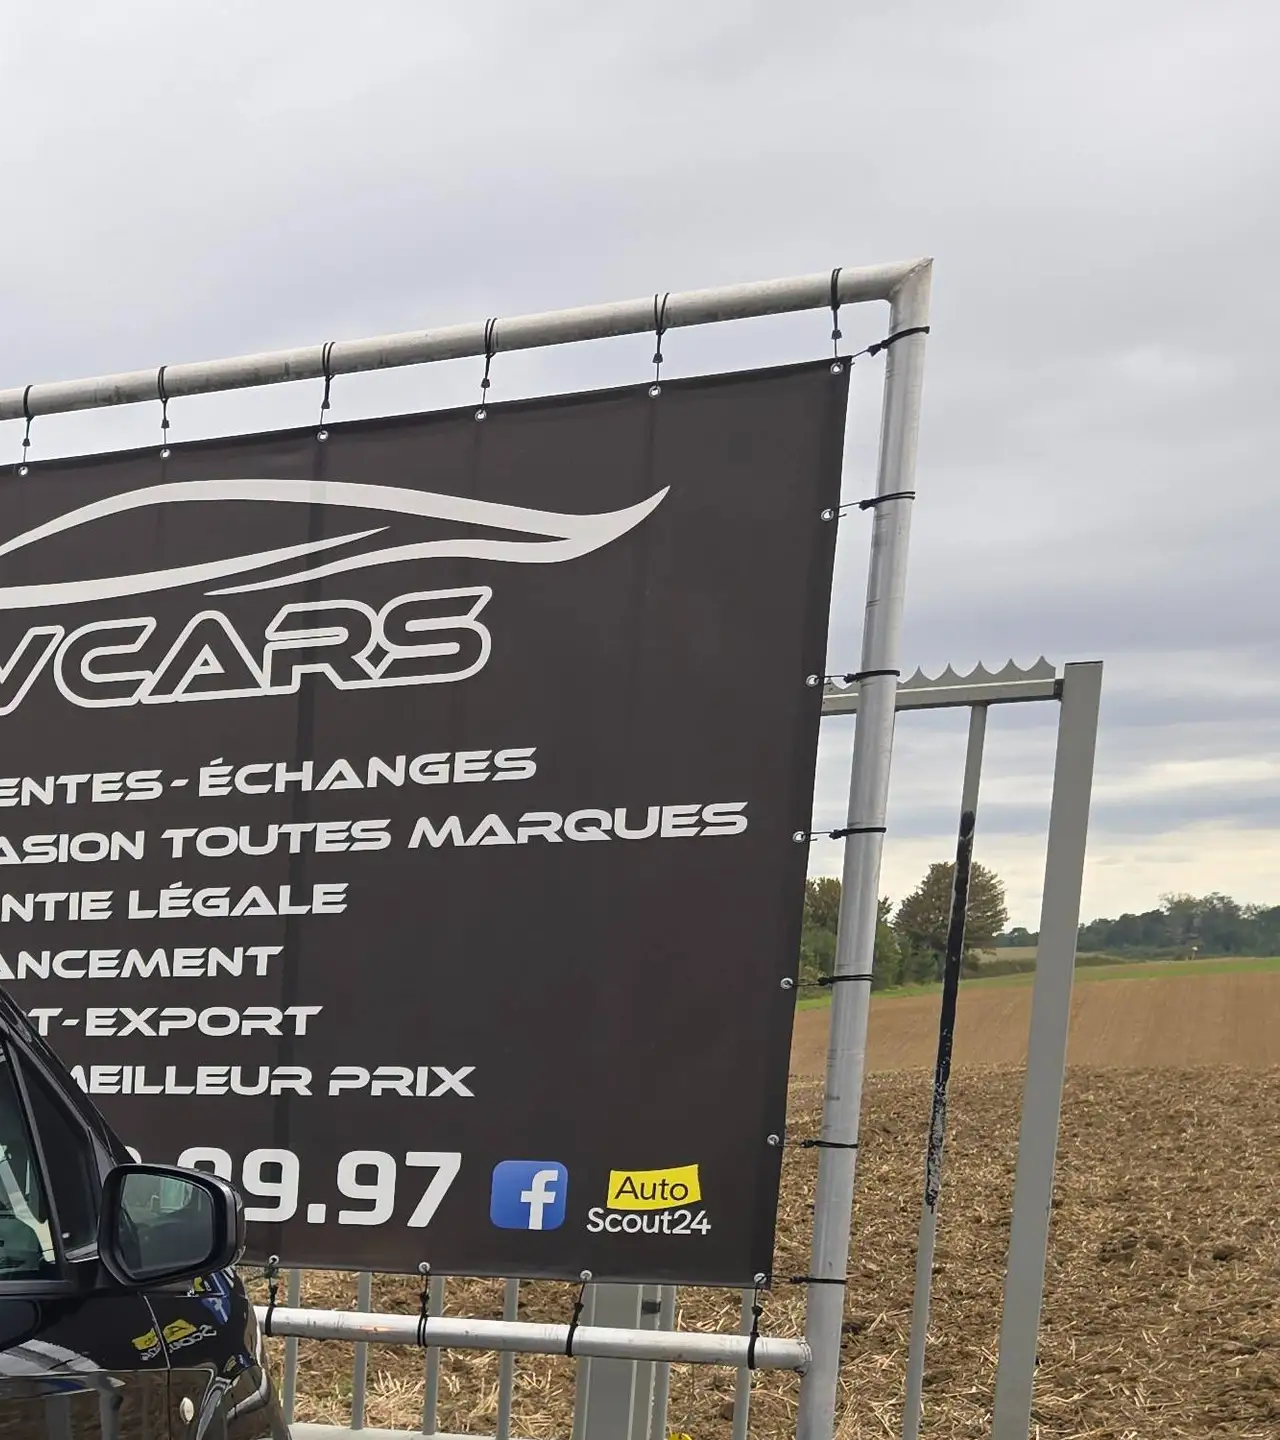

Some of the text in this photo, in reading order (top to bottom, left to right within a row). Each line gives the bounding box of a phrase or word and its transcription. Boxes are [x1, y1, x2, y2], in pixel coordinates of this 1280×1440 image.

[161, 819, 391, 859] TOUTES
[407, 802, 749, 850] MARQUES
[128, 881, 350, 920] LÉGALE
[27, 1005, 324, 1037] T-EXPORT
[329, 1066, 477, 1098] PRIX
[614, 1176, 690, 1202] Auto
[586, 1207, 712, 1236] Scout24
